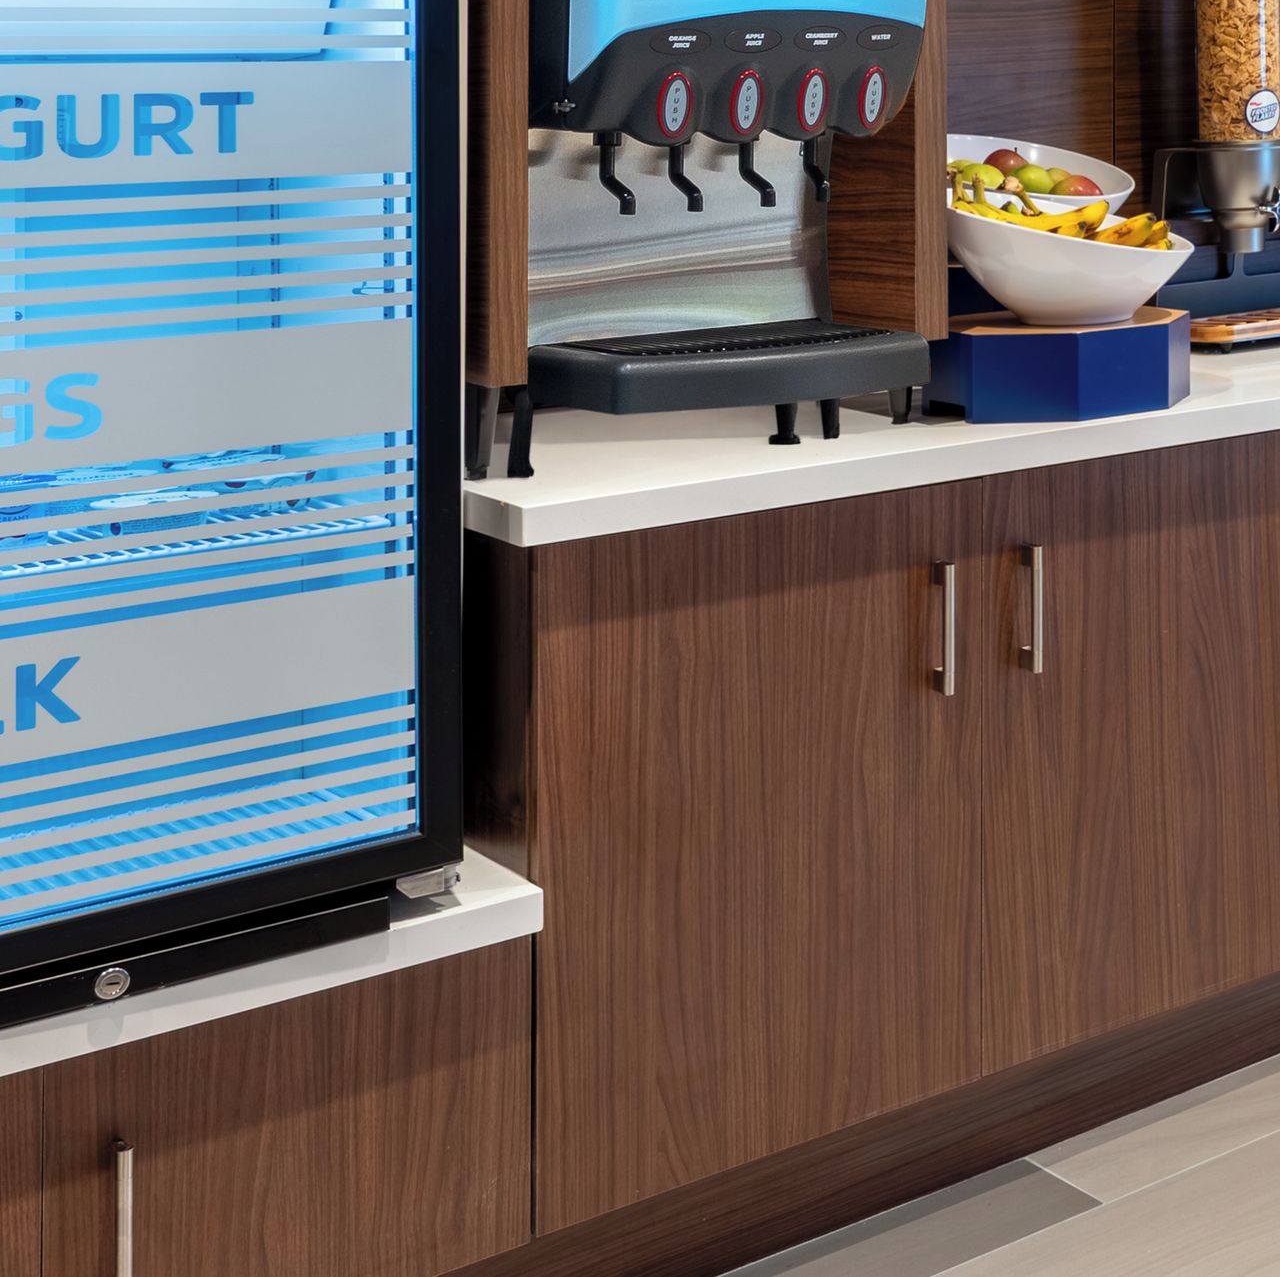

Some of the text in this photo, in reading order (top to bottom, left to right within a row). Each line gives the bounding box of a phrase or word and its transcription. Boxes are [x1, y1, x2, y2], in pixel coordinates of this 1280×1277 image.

[871, 33, 892, 41] WATER
[671, 87, 681, 124] PUSH
[743, 85, 752, 122] PUSH
[809, 82, 818, 118] PUSH
[869, 79, 878, 115] PUSH
[0, 91, 255, 161] GURT
[0, 655, 82, 736] K
